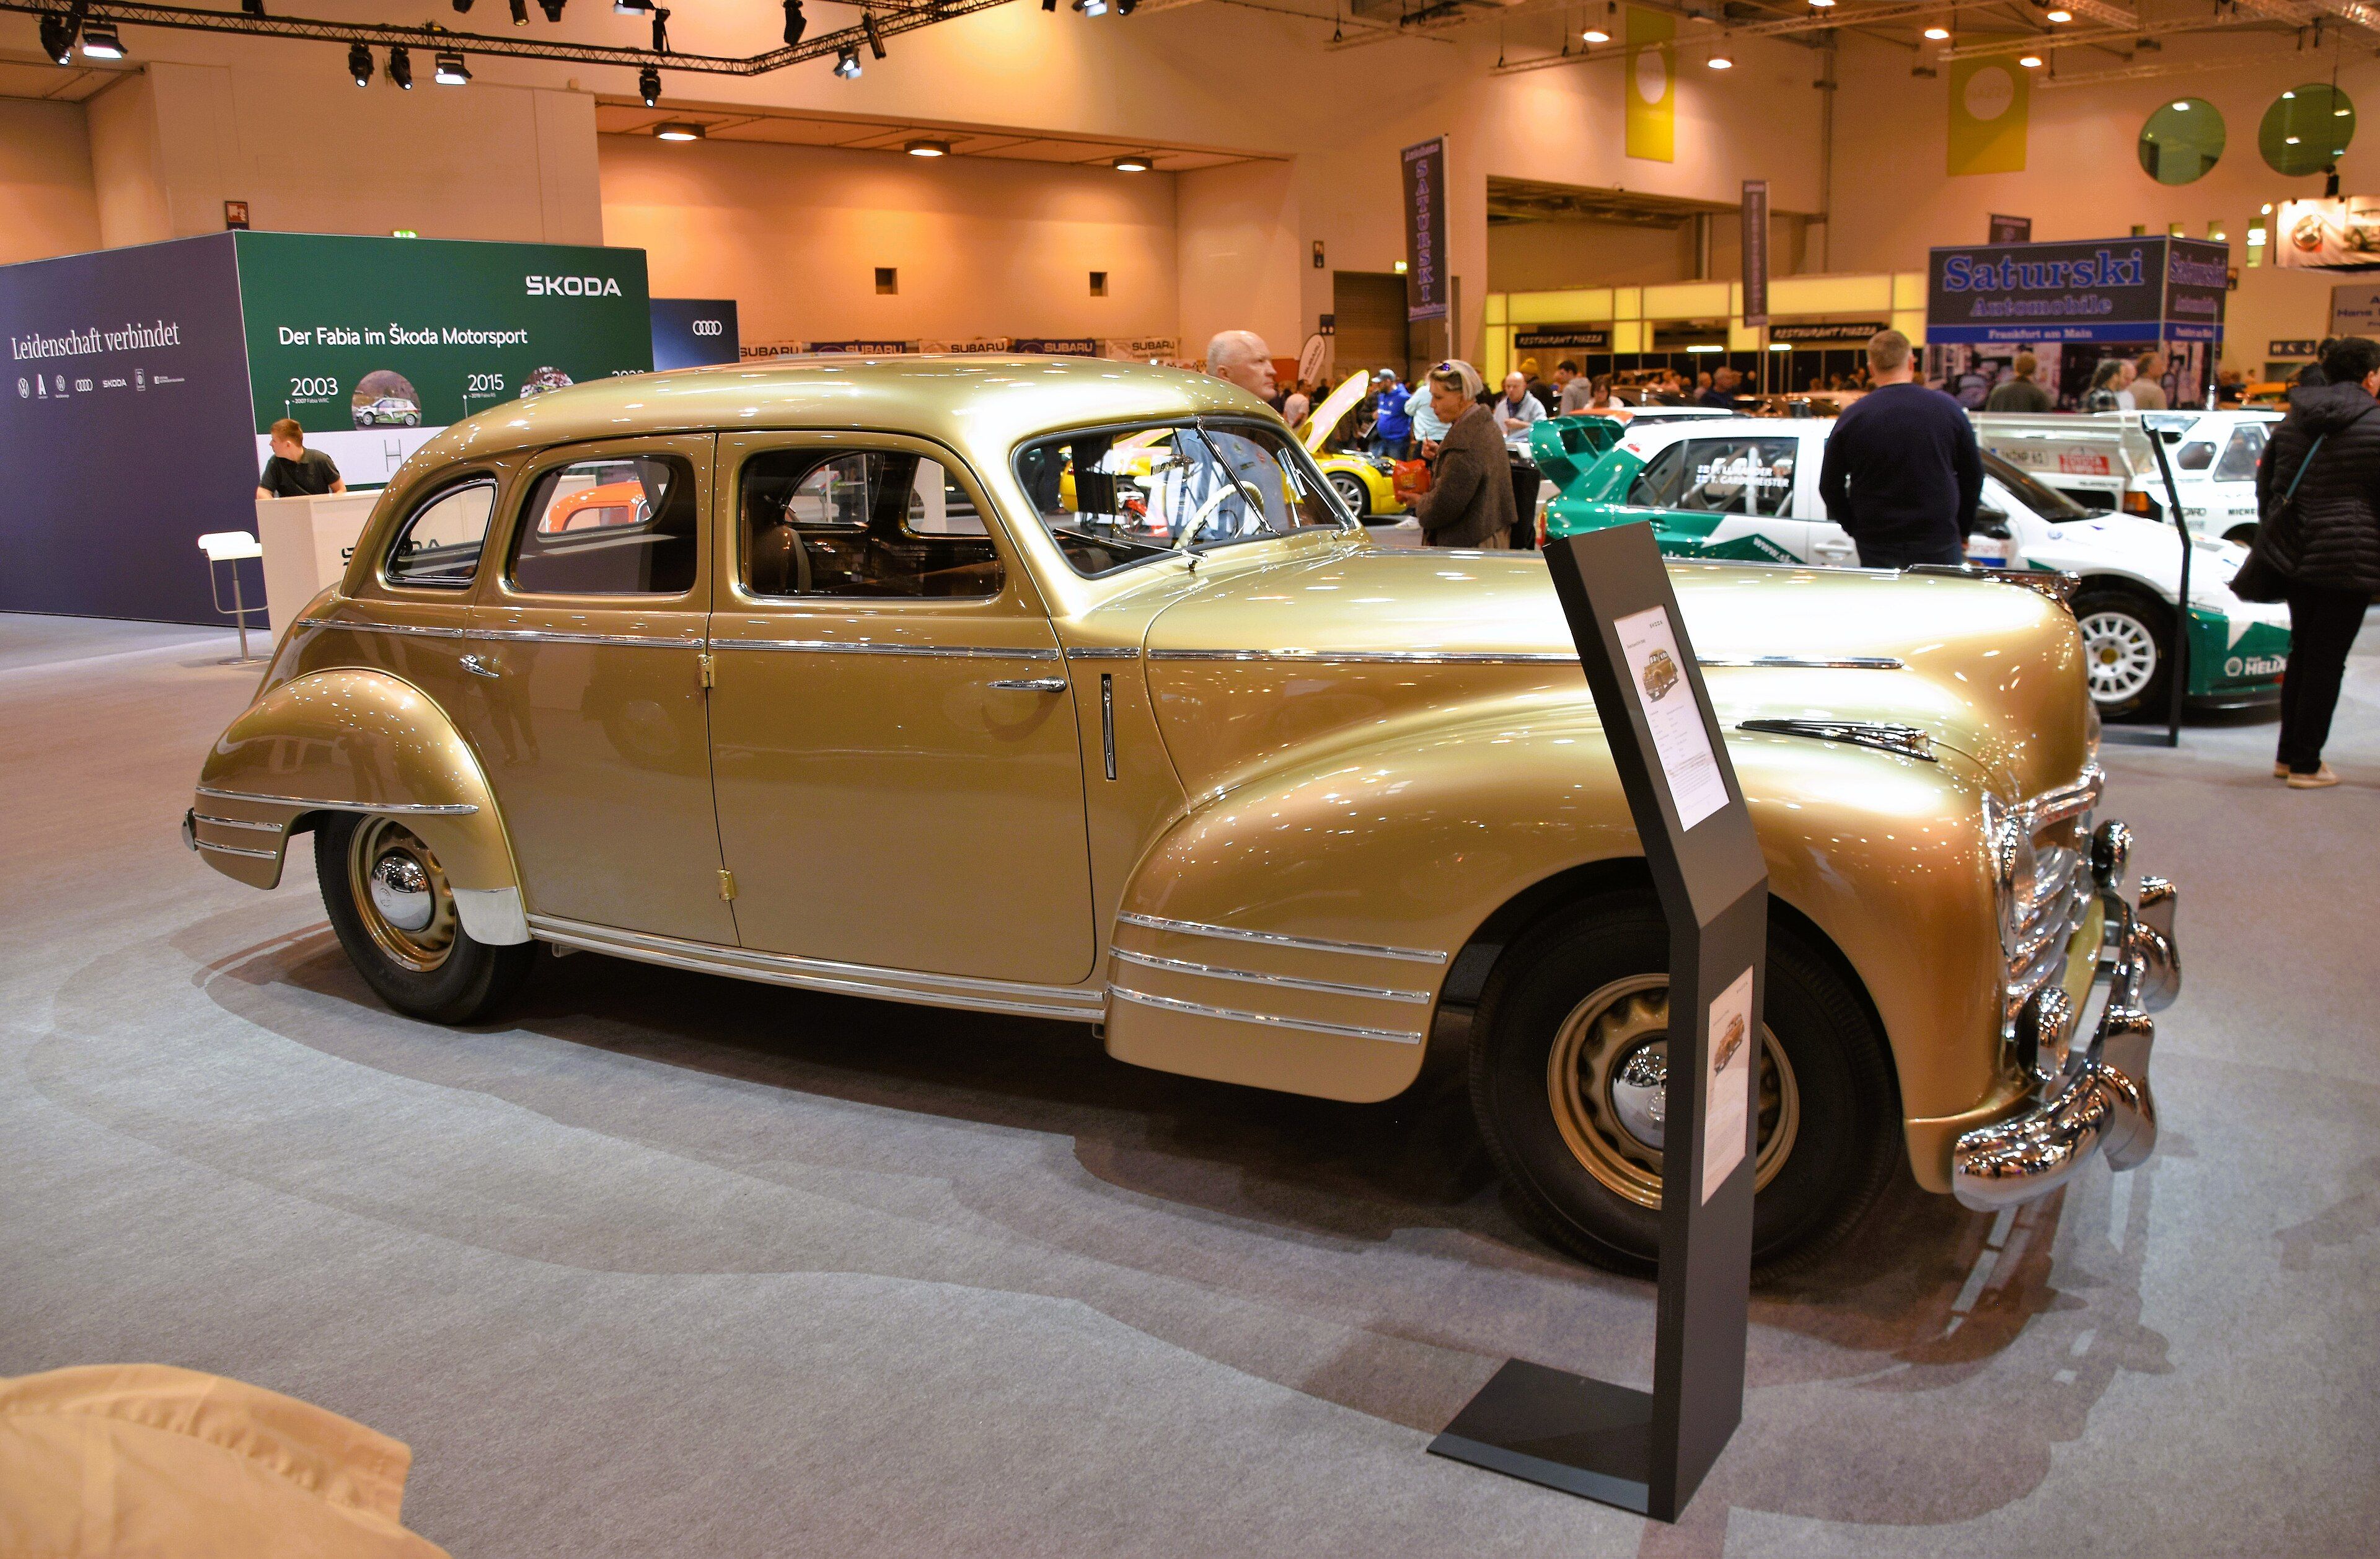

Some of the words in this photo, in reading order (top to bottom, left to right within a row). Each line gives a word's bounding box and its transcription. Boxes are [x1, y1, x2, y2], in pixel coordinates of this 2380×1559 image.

[1944, 249, 2145, 292] Saturski
[1970, 294, 2113, 317] Automobile
[12, 327, 104, 360] Leidenschaft
[105, 320, 181, 351] verbindet
[279, 326, 312, 345] Der
[316, 327, 361, 345] Fabia
[364, 327, 386, 345] im
[389, 322, 438, 345] Škoda
[442, 327, 528, 348] Motorsport
[1988, 329, 2042, 339] Frankfurt
[739, 346, 799, 356] SUBARU
[845, 345, 902, 355] SUBARU
[951, 342, 1005, 353] SUBARU
[1044, 342, 1093, 353] SUBARU
[1132, 340, 1175, 351] SUBARU
[290, 377, 338, 397] 2003
[467, 374, 505, 391] 2015
